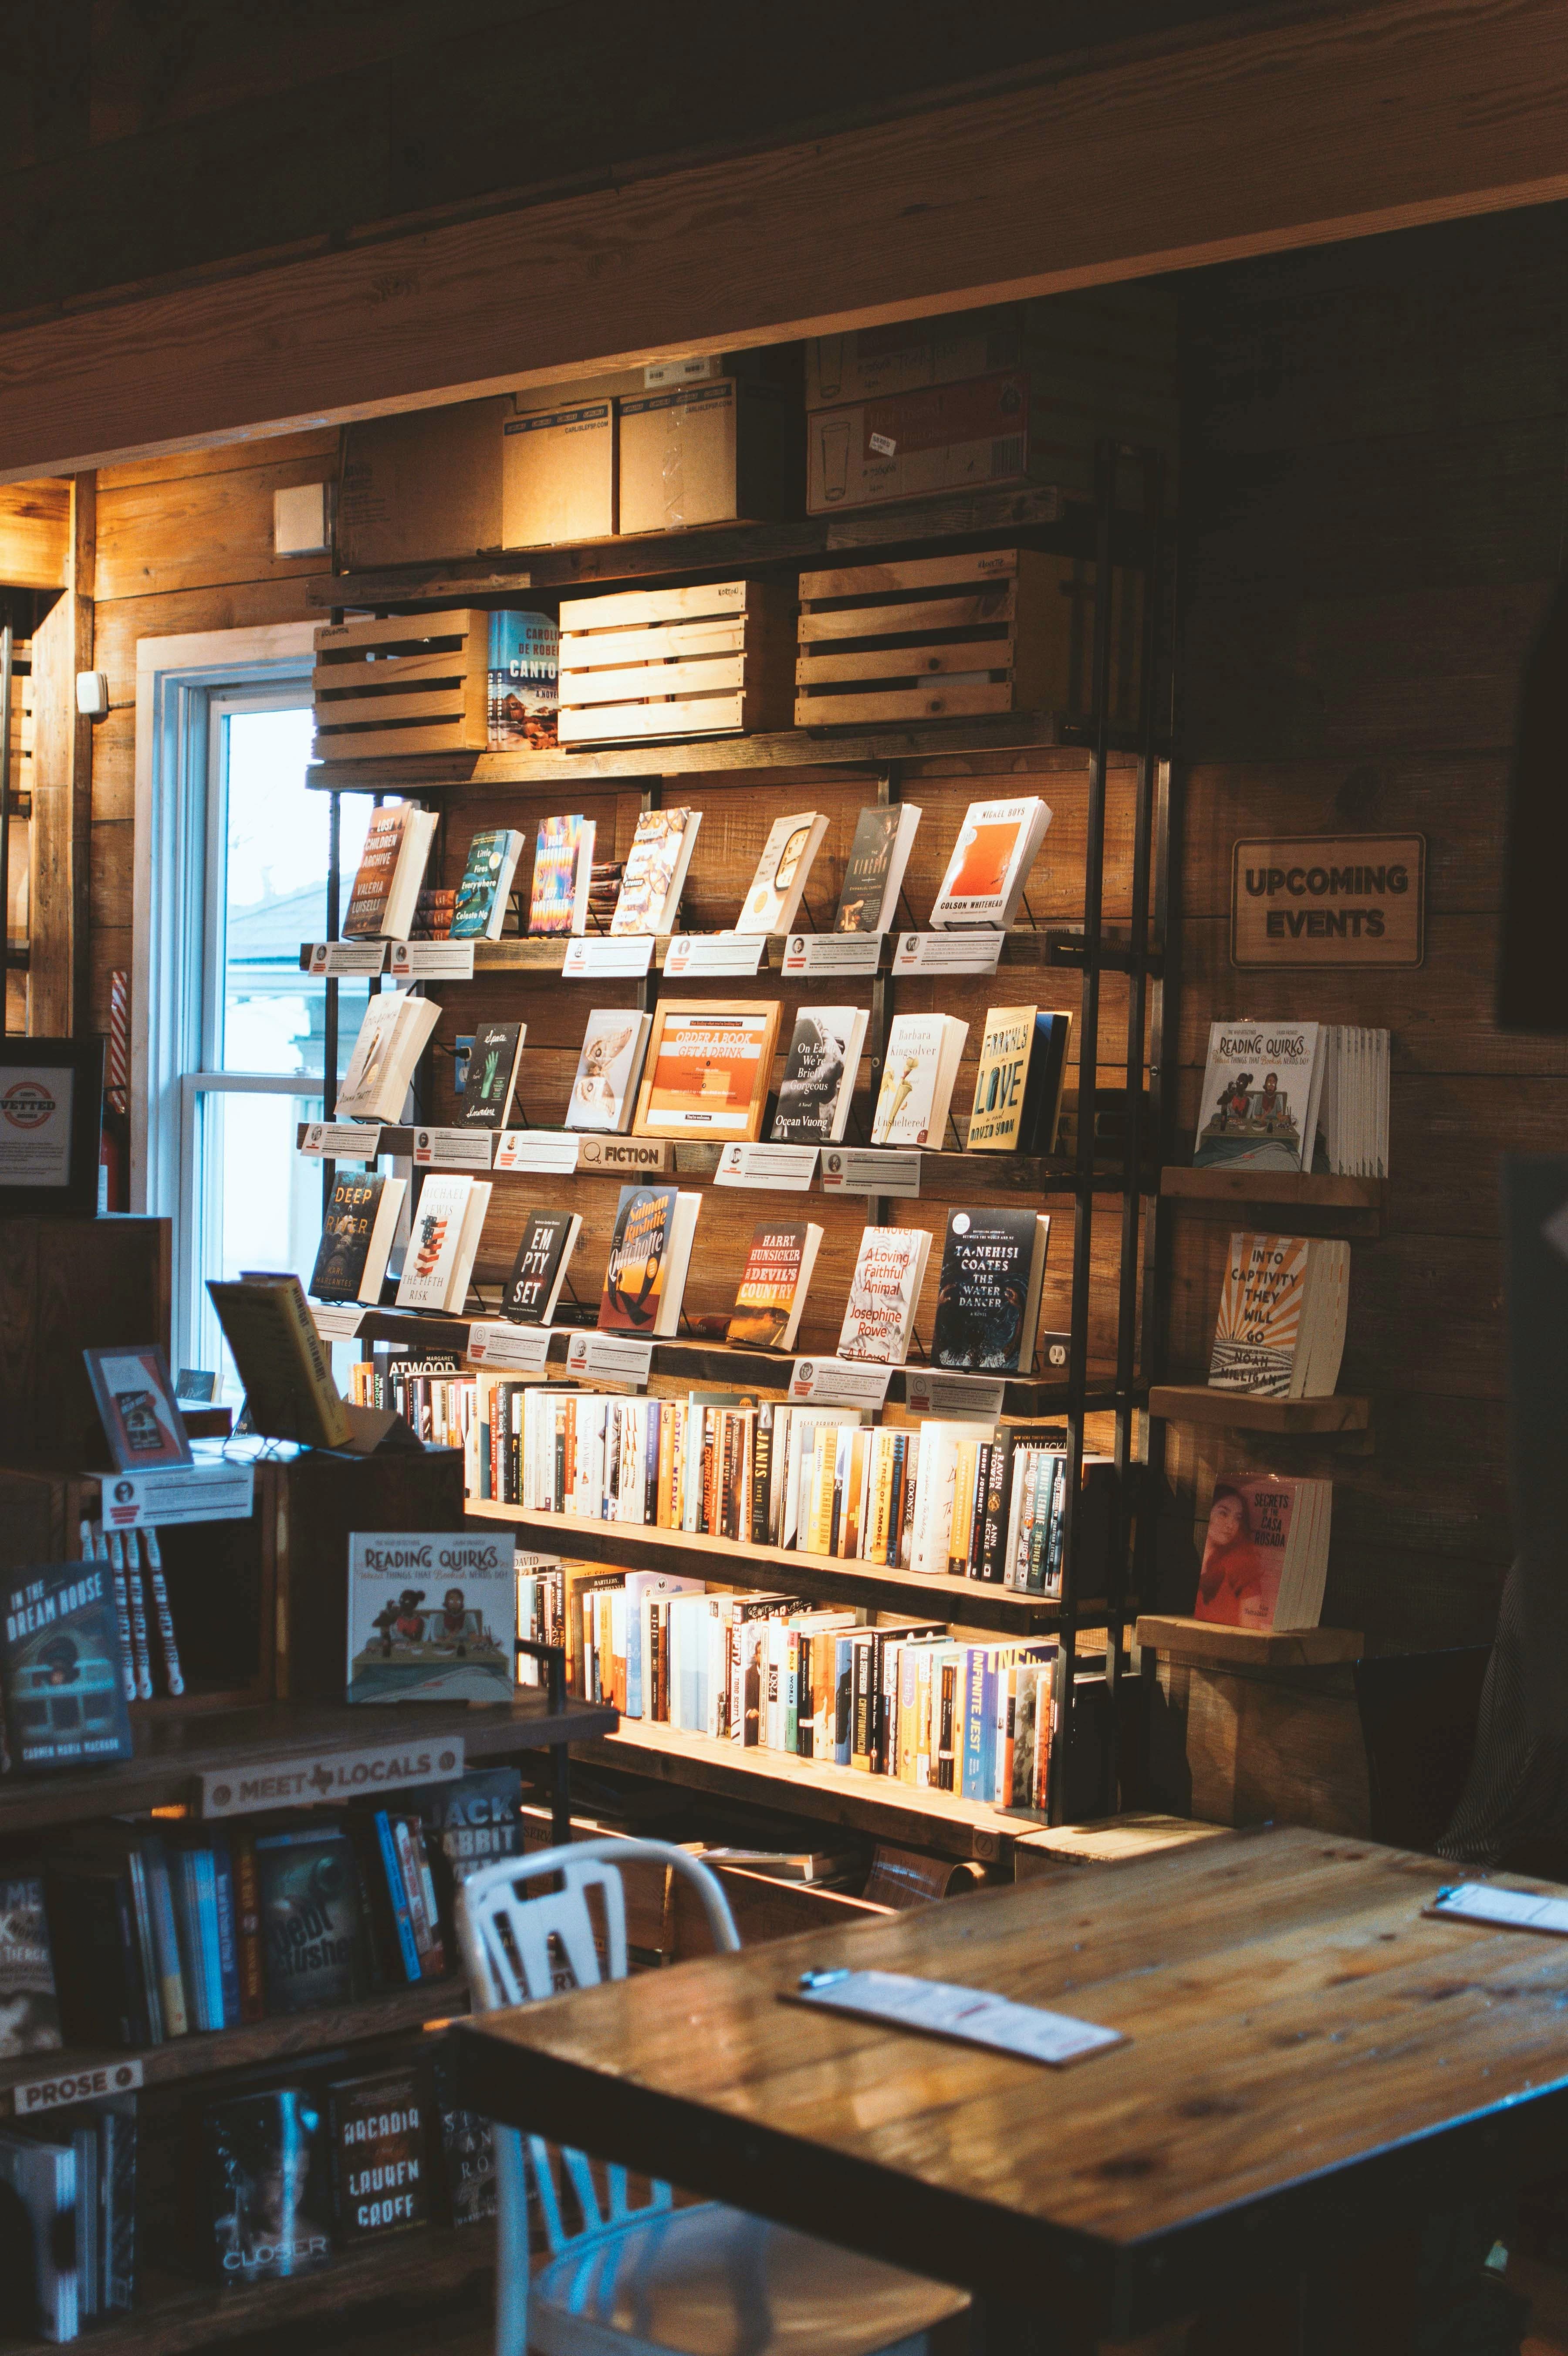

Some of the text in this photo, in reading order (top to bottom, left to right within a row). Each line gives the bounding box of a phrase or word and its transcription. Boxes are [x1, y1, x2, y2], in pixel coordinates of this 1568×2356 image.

[519, 643, 529, 654] DE
[982, 807, 1025, 819] NICKEL BOYS
[377, 817, 395, 833] LOST
[364, 834, 397, 851] CHILDREN
[362, 852, 392, 868] ARCHIVE
[477, 849, 491, 858] Little
[474, 864, 488, 873] Fires
[853, 856, 887, 875] KINGDOM
[357, 880, 384, 896] VALERIA
[462, 880, 497, 891] Everywhere
[1245, 864, 1409, 897] UPCOMING
[352, 898, 381, 914] LUISELLI
[940, 899, 1003, 910] COLSON WHITEHEAD
[456, 910, 488, 920] Celeste Ng
[1266, 908, 1386, 938] EVENTS
[484, 1030, 507, 1046] Space
[676, 1032, 753, 1044] ORDER A BOOK
[899, 1028, 931, 1040] Barbara
[983, 1024, 1028, 1059] FRANKLY
[678, 1046, 745, 1058] GET A DRINK
[798, 1043, 810, 1053] On
[890, 1044, 936, 1060] Kingsolver
[1220, 1035, 1304, 1057] READING QUIRKS
[803, 1055, 826, 1066] We're
[798, 1067, 825, 1082] Briefly
[790, 1080, 828, 1094] Gorgeous
[974, 1060, 1024, 1115] LOVE
[0, 1100, 56, 1110] VETTED
[776, 1115, 828, 1131] Ocean Vuong
[877, 1116, 926, 1127] Unsheltered
[970, 1124, 994, 1142] DAVID
[996, 1118, 1015, 1136] YOON
[605, 1146, 659, 1164] FICTION
[335, 1187, 372, 1205] DEEP
[423, 1188, 463, 1199] MICHAEL
[425, 1204, 453, 1216] LEWIS
[629, 1195, 669, 1225] Salman
[325, 1215, 368, 1234] RIVER
[624, 1211, 666, 1245] Rushdie
[531, 1228, 554, 1250] EM
[762, 1235, 796, 1247] HARRY
[608, 1231, 663, 1282] Quichotte
[750, 1249, 800, 1262] HUNSICKER
[865, 1249, 911, 1267] A Loving,
[955, 1246, 1019, 1258] TA-NEHISI
[1252, 1249, 1284, 1265] INTO
[328, 1266, 343, 1275] KARL
[521, 1251, 550, 1275] PTY
[961, 1260, 1009, 1271] COATES
[751, 1268, 798, 1281] DEVIL'S
[865, 1264, 905, 1280] Faithful
[973, 1274, 994, 1284] THE
[1231, 1268, 1298, 1287] CAPTIVITY
[315, 1277, 352, 1287] MARLANTES
[402, 1275, 443, 1287] THE FIFTH
[863, 1280, 900, 1295] Animal
[409, 1290, 428, 1301] RISK
[513, 1281, 541, 1304] SET
[741, 1283, 794, 1300] COUNTRY
[963, 1285, 1000, 1296] WATER
[1245, 1288, 1280, 1305] THEY
[959, 1297, 1002, 1307] DANCER
[850, 1306, 902, 1323] Josephine
[1244, 1309, 1273, 1324] WILL
[858, 1322, 887, 1337] Rowe
[1247, 1330, 1264, 1344] GO
[1234, 1352, 1269, 1367] NOAH
[1220, 1367, 1277, 1386] MILLIGAN
[755, 1430, 769, 1478] JANIS
[989, 1453, 998, 1489] TOWER
[995, 1455, 1004, 1489] RAVEN
[1024, 1452, 1037, 1521] ANCILLARY JUSTICE
[1035, 1460, 1051, 1525] DENNIS LEHANE
[880, 1491, 885, 1504] OF
[906, 1480, 915, 1520] KOONTZ
[1254, 1493, 1289, 1510] SECRETS
[1261, 1516, 1282, 1533] CASA
[1255, 1531, 1285, 1547] ROSADA
[365, 1545, 498, 1572] READING QUIRKS
[1033, 1544, 1041, 1562] GIVEN
[10, 1578, 44, 1611] IN THE
[6, 1571, 103, 1642] DREAM HOUSE
[769, 1670, 777, 1697] 1984
[859, 1660, 868, 1694] STEPHENSON
[970, 1651, 984, 1753] INFINITE JEST
[857, 1698, 867, 1754] CRYPTONOMICON
[24, 1743, 81, 1760] CARMEN MARIA
[239, 1753, 432, 1802] MEET LOCALS
[26, 2072, 108, 2108] PROSE
[343, 2107, 419, 2146] ARCADIA
[348, 2158, 419, 2197] LAUREN
[356, 2193, 415, 2227] GROFF
[223, 2236, 328, 2271] CLOSER
